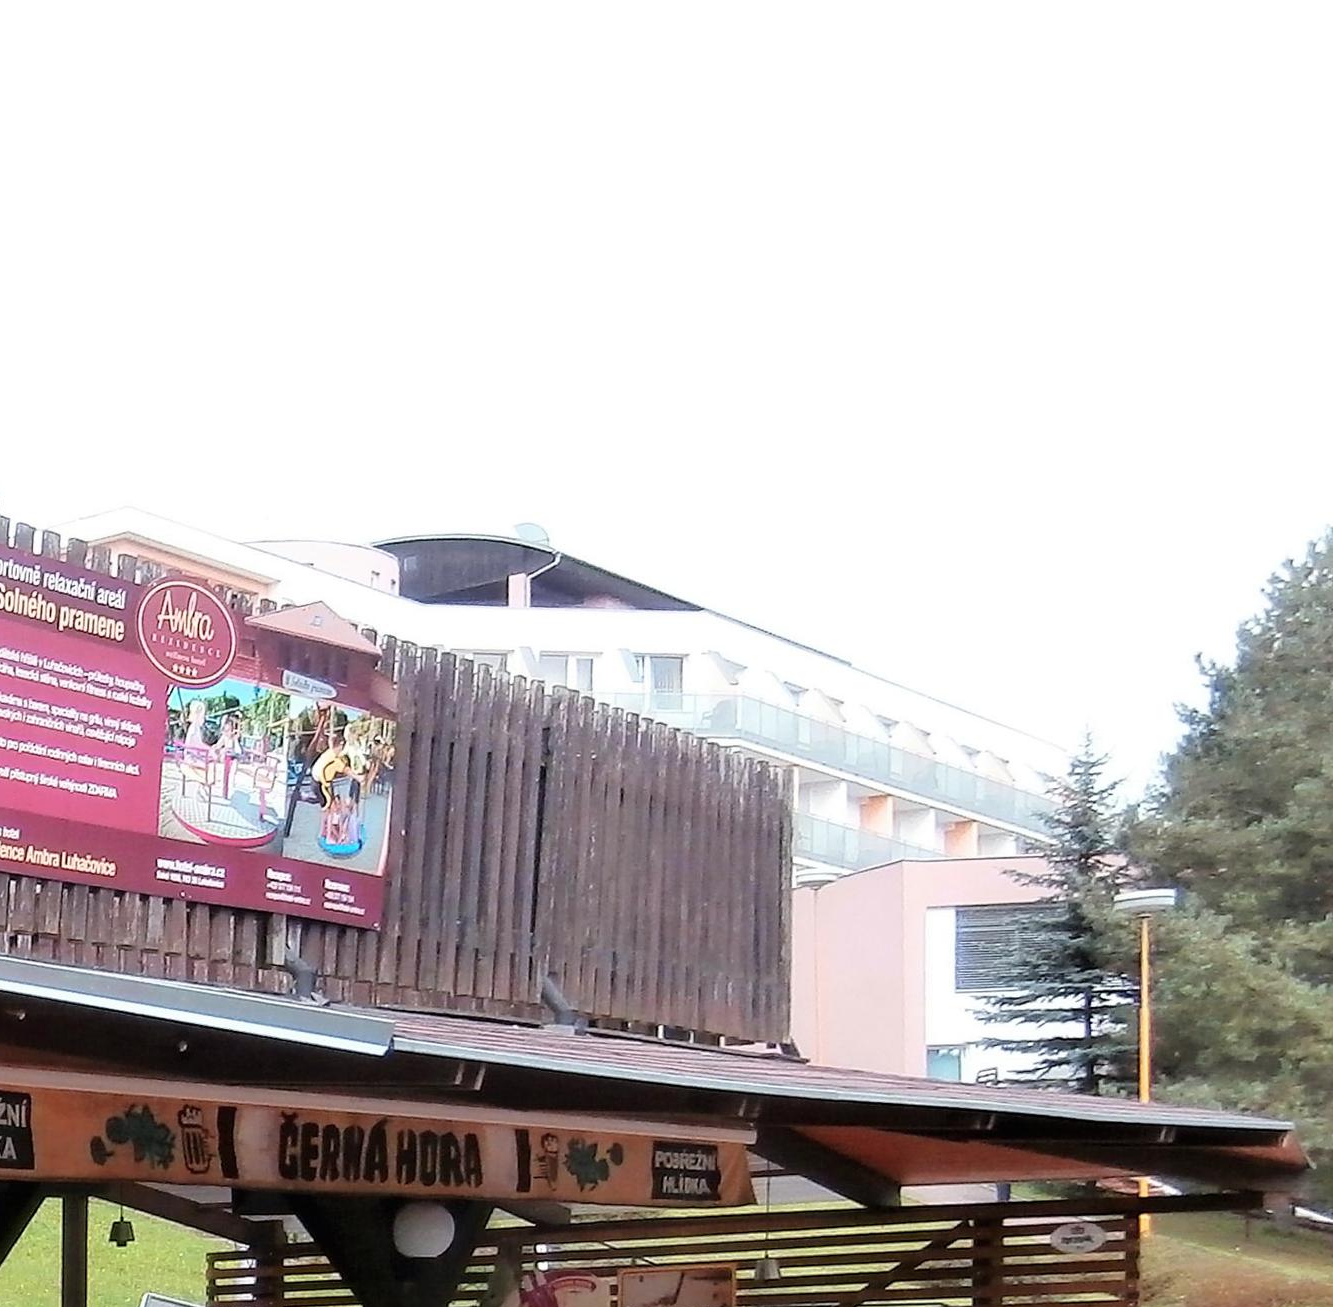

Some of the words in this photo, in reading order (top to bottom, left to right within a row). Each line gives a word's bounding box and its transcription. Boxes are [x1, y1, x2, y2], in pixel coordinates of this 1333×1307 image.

[43, 571, 95, 601] relaxační
[97, 586, 127, 610] areál
[58, 604, 125, 642] pramene
[157, 590, 214, 641] Ambra
[26, 845, 61, 868] Ambra
[61, 851, 117, 877] Luhačovice
[278, 1111, 389, 1184] ČERNÁ
[395, 1128, 484, 1188] HORA
[655, 1148, 717, 1172] POBŘEŽNÍ
[662, 1173, 713, 1195] HLÍDKA
